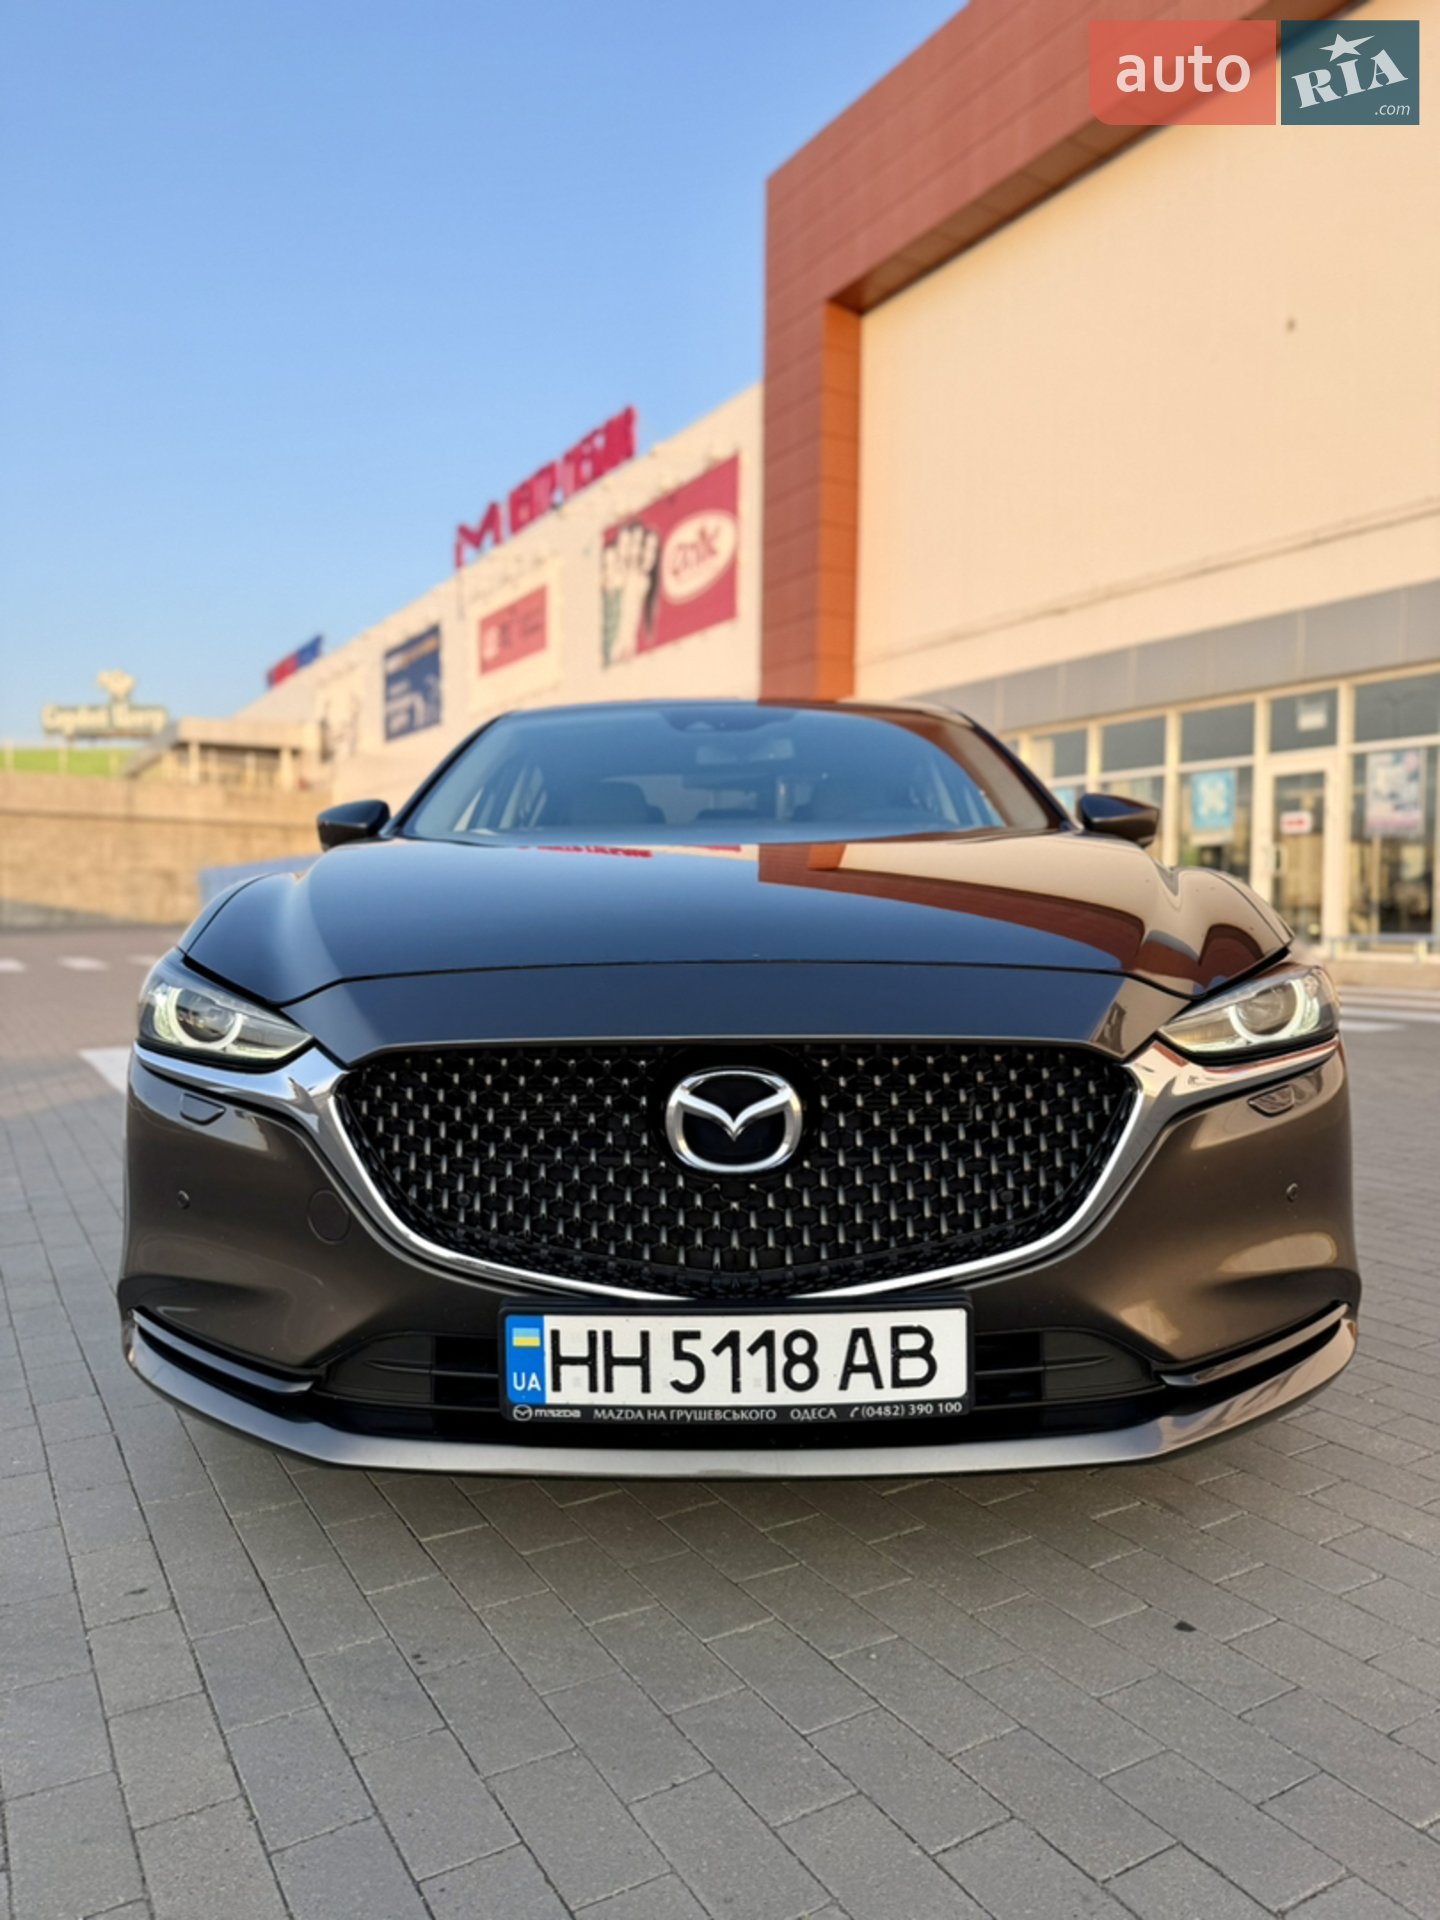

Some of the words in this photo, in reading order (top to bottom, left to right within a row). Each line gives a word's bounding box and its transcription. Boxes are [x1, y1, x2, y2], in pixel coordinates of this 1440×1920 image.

[550, 1329, 652, 1393] HH
[669, 1329, 819, 1394] 5118
[838, 1325, 938, 1391] AB
[513, 1371, 541, 1391] UA
[593, 1408, 642, 1420] MAZDA
[649, 1409, 667, 1420] НА
[669, 1408, 777, 1422] ГРУШЕВСЬКОГО
[790, 1408, 837, 1421] ОДЕСА
[861, 1404, 905, 1418] (0482)
[908, 1403, 933, 1415] 390
[938, 1401, 962, 1413] 100
